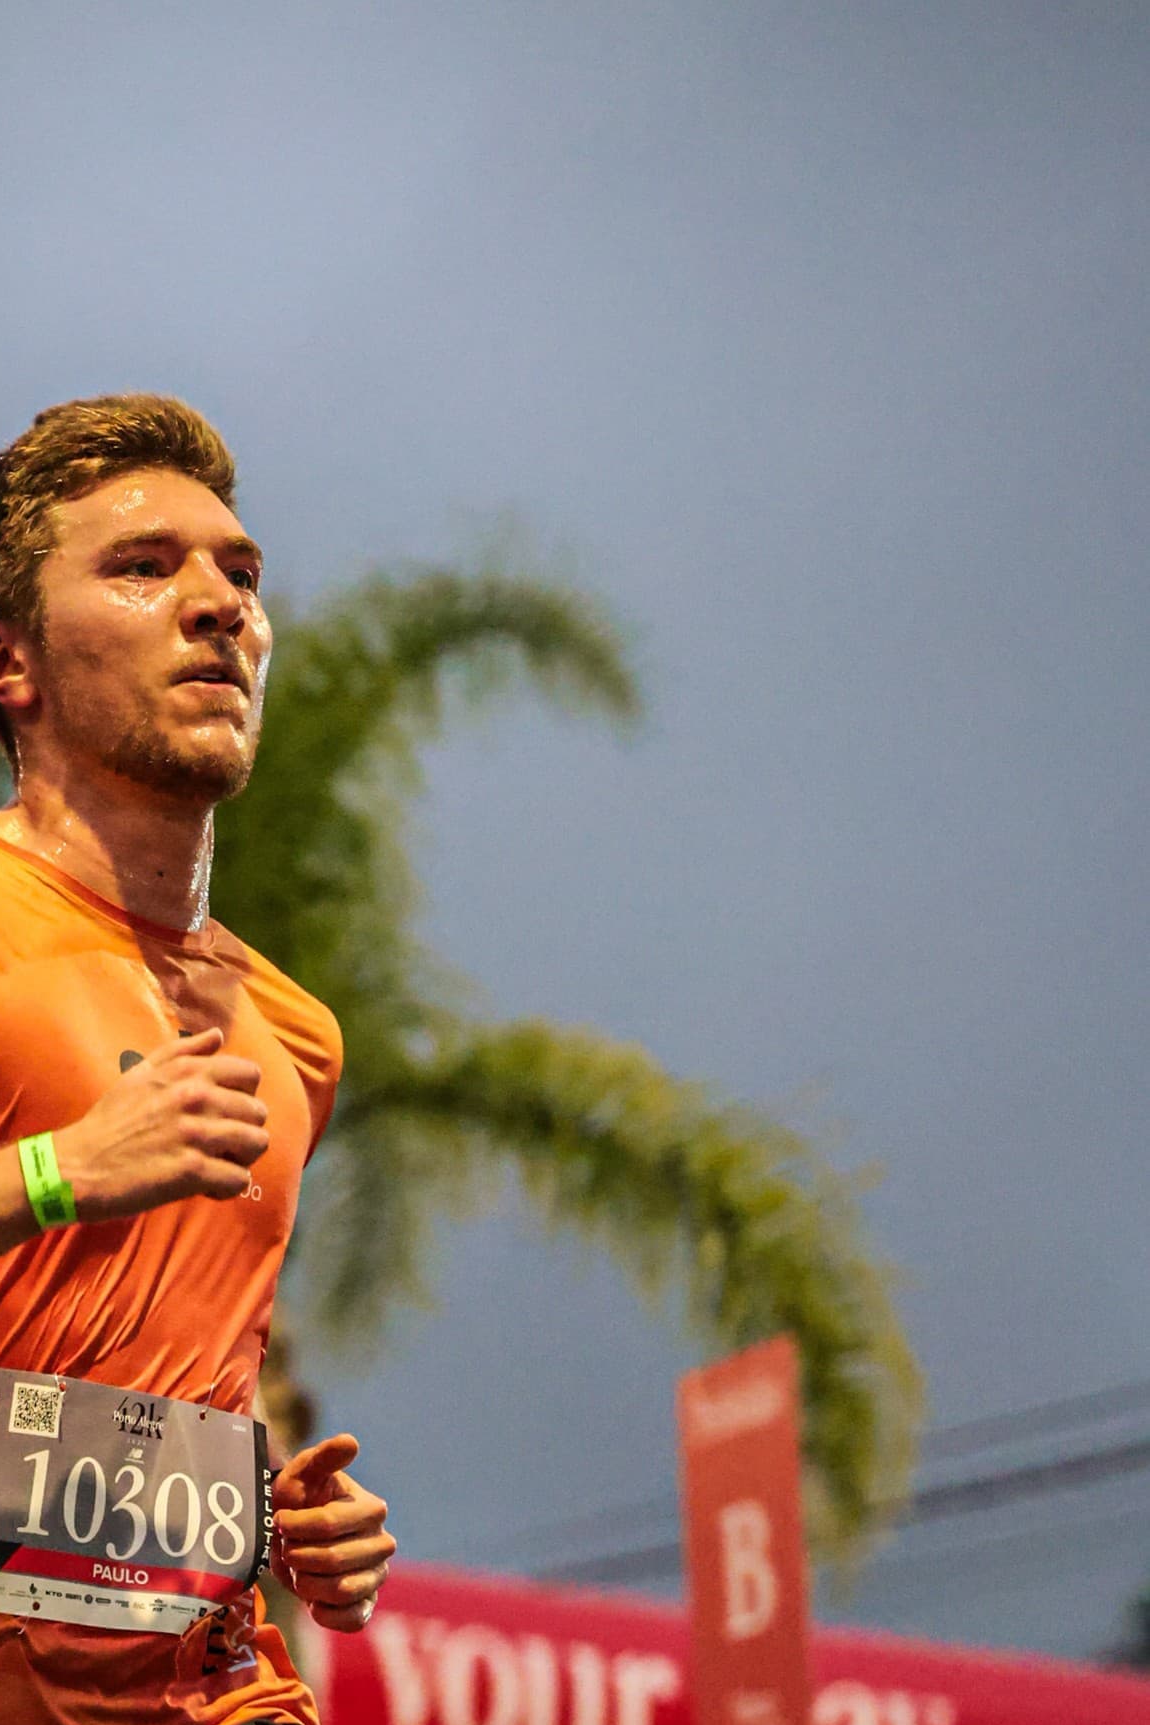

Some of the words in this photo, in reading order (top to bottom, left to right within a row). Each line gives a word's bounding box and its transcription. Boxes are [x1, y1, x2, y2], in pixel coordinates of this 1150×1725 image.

[112, 1396, 163, 1440] 42k
[113, 1410, 137, 1425] Porto
[16, 1449, 246, 1565] 10308
[256, 1468, 275, 1576] PELOTÃO
[92, 1563, 149, 1585] PAULO
[719, 1499, 777, 1641] B
